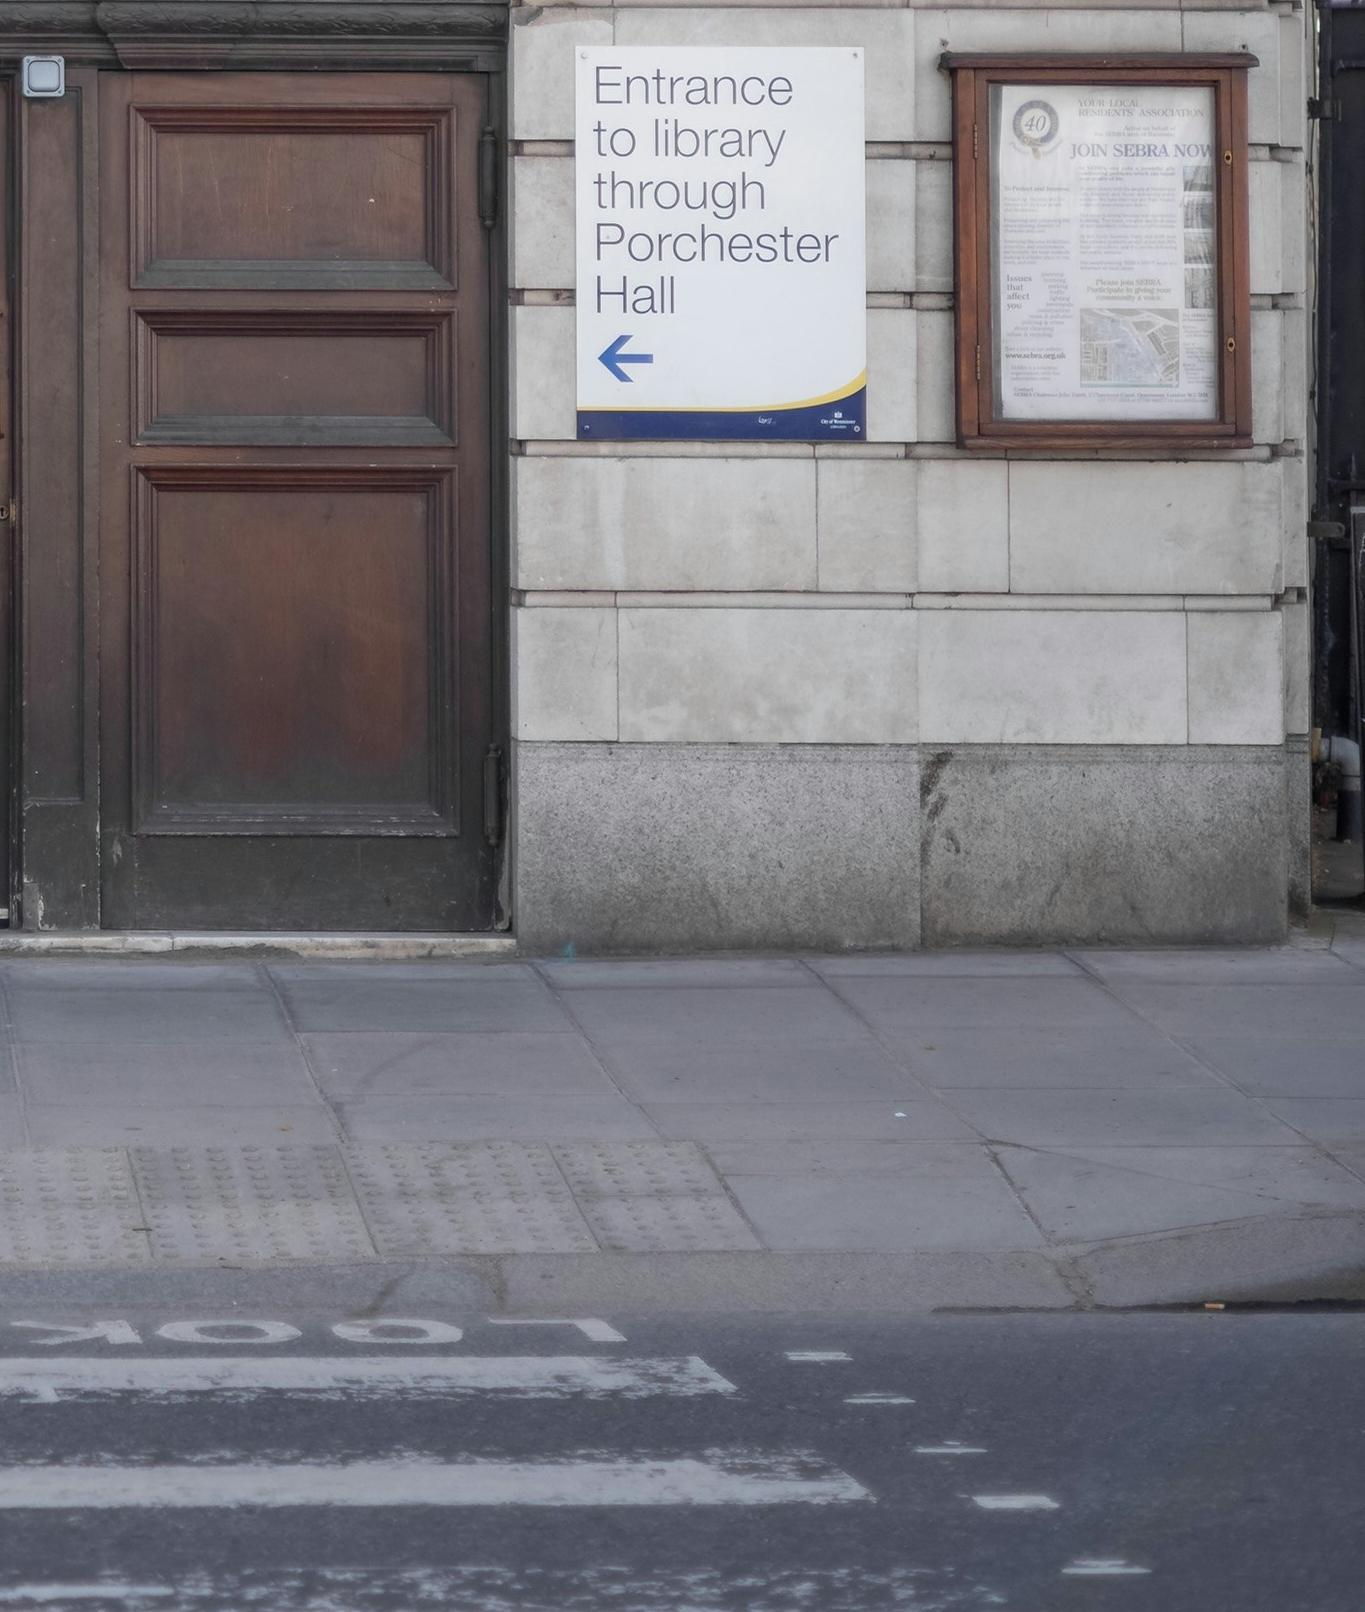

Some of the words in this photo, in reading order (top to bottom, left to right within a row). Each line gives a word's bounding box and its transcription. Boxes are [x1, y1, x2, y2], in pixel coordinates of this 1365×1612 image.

[594, 66, 793, 106] Entrance
[1078, 99, 1105, 107] YOUR
[1109, 99, 1142, 107] LOCAL
[1139, 108, 1205, 117] ASSOCIATION
[1024, 115, 1047, 132] 40
[593, 120, 637, 158] to
[653, 118, 786, 167] library
[1070, 144, 1108, 159] JOIN
[1112, 144, 1169, 158] SEBRA
[593, 171, 766, 220] through
[595, 222, 840, 264] Porchester
[1006, 274, 1033, 282] Issues
[1095, 278, 1118, 286] Please
[1120, 278, 1134, 287] join
[1135, 278, 1162, 286] SEBRA
[596, 275, 676, 315] Hall
[1006, 292, 1030, 300] affect
[1005, 351, 1066, 360] www.sebra.org.uk
[9, 1318, 627, 1345] LOOK
